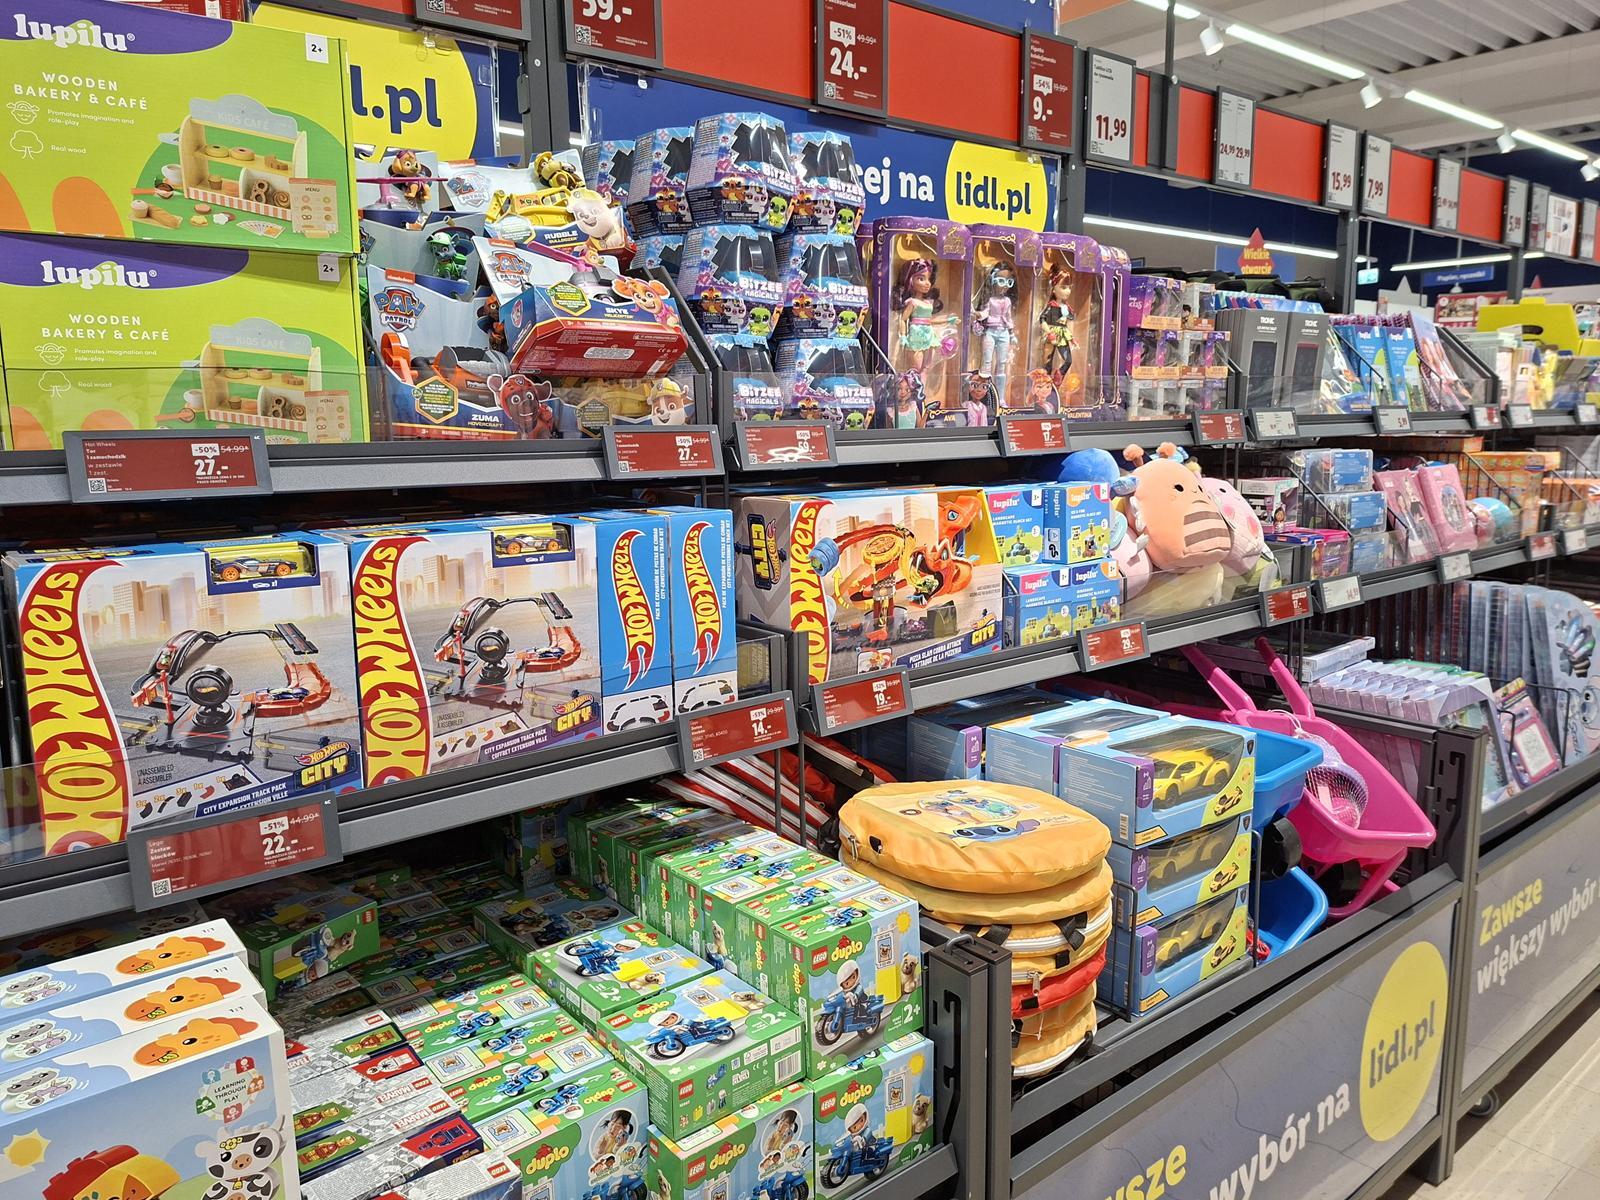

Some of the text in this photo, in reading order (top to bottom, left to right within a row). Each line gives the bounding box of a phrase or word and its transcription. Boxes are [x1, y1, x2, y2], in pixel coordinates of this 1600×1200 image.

[13, 13, 129, 51] lupilu
[834, 28, 852, 39] -51%
[310, 44, 323, 54] 2+
[830, 47, 867, 80] 24.-
[42, 71, 118, 91] WOODEN
[13, 84, 148, 110] BAKERY & CAFÉ
[1034, 96, 1052, 121] 9.-
[77, 112, 118, 124] imagination
[120, 116, 134, 125] and
[1096, 115, 1126, 141] 11.99
[51, 144, 86, 154] Real wood
[899, 171, 934, 201] na
[956, 171, 1031, 219] lidl.pl
[544, 231, 578, 239] RUBBLE
[1244, 248, 1270, 259] Wielkie
[41, 261, 150, 289] lupilu
[322, 264, 335, 274] 2+
[1241, 263, 1272, 274] otwarcie
[374, 290, 426, 318] PAW
[68, 313, 142, 326] WOODEN
[384, 316, 412, 326] PATROL
[41, 327, 170, 341] BAKERY & CAFÉ
[103, 348, 143, 357] imagination
[471, 414, 499, 422] ZUMA
[678, 448, 698, 460] 27.-
[194, 459, 229, 475] 27.-
[993, 498, 1019, 508] lupilu
[750, 523, 770, 577] CITY
[971, 624, 996, 645] CITY
[874, 693, 891, 705] 19.-
[557, 705, 592, 732] CITY
[752, 722, 771, 735] 14.-
[484, 728, 547, 755] CITY EXPANSION TRACK PACK
[491, 735, 548, 760] COFFRET EXTENSION VILLE
[136, 764, 174, 777] UNASSEMBLED
[141, 773, 173, 784] ASSEMBLER
[300, 755, 349, 786] CITY
[203, 783, 287, 814] CITY EXPANSION TRACK PACK
[271, 791, 288, 802] VILLE
[264, 820, 284, 831] -51%
[262, 835, 298, 856] 22.-
[1478, 875, 1543, 948] Zawsze
[1475, 884, 1595, 995] większy wybór
[812, 941, 862, 964] LEGO duplo
[633, 1001, 670, 1018] duplo
[764, 1010, 787, 1025] 2+
[903, 1004, 921, 1024] 2+
[425, 1019, 455, 1033] duplo
[1368, 999, 1437, 1089] lidl.pl
[213, 1078, 246, 1094] LEARNING
[469, 1074, 501, 1091] duplo
[679, 1085, 693, 1096] LEGO
[214, 1084, 248, 1100] THROUGH
[223, 1094, 240, 1104] PLAY
[376, 1085, 411, 1103] MARVEL
[820, 1084, 872, 1111] LEGO duplo
[394, 1111, 429, 1130] MARVEL
[1209, 1082, 1351, 1200] wybór na
[526, 1146, 569, 1175] duplo
[689, 1142, 746, 1178] LEGO duplo
